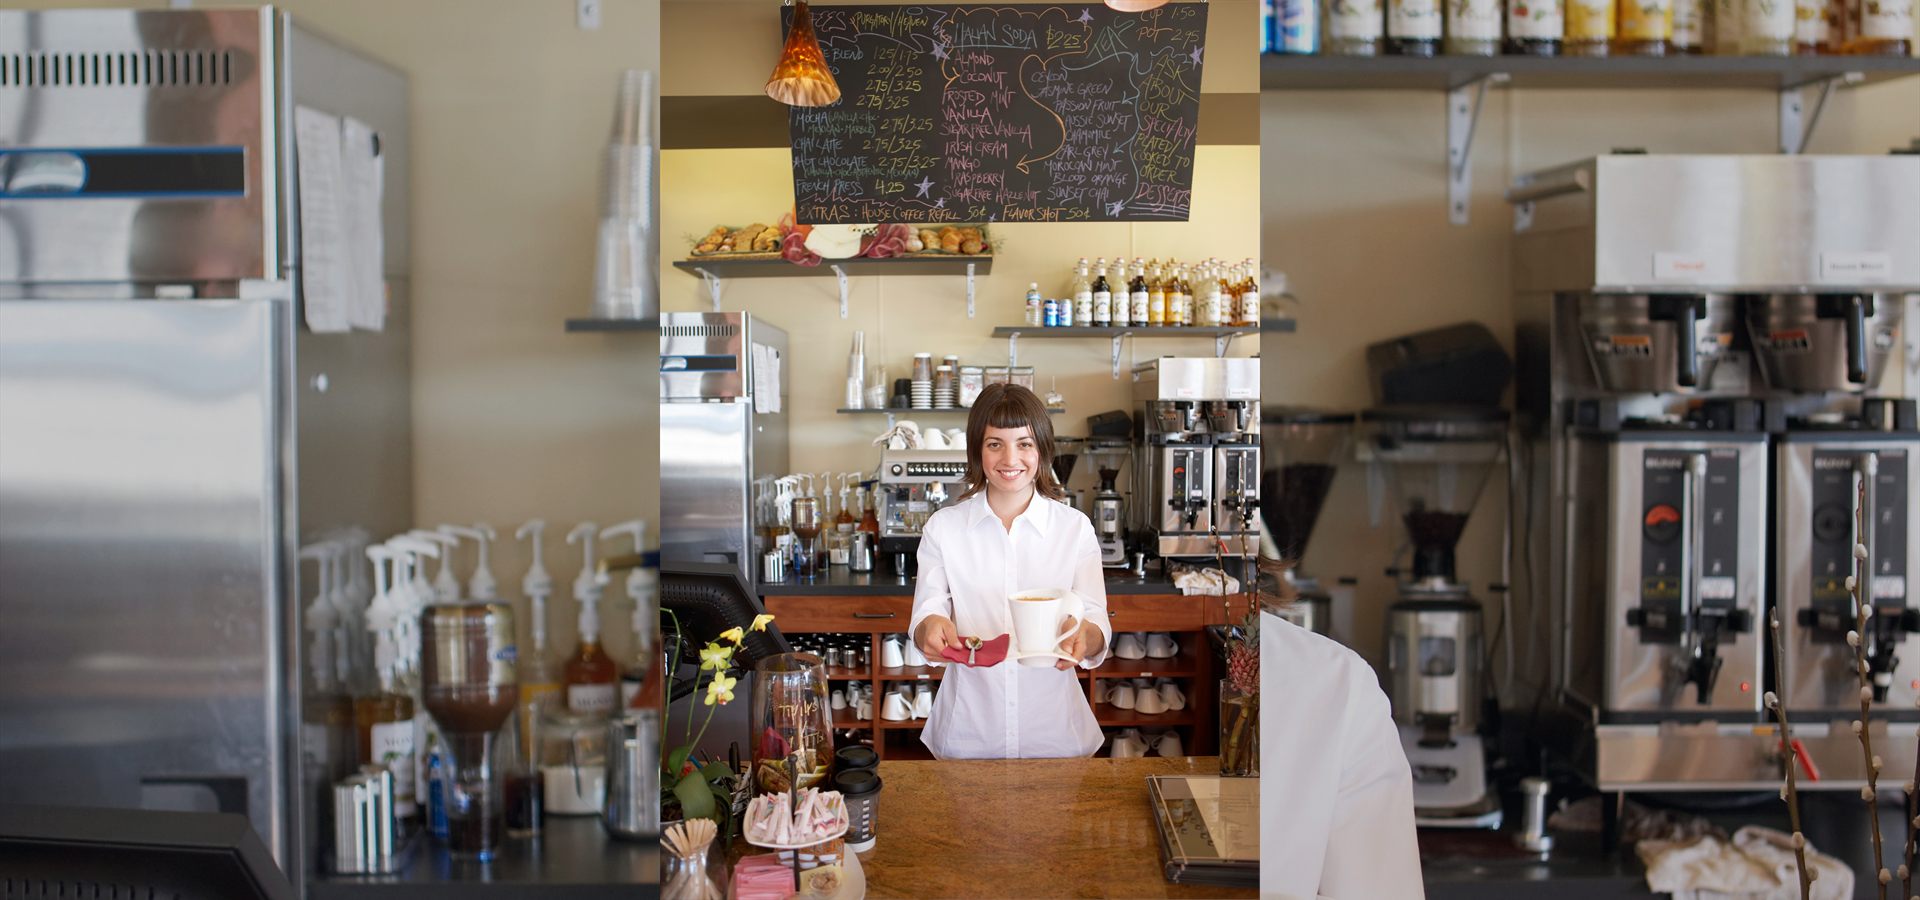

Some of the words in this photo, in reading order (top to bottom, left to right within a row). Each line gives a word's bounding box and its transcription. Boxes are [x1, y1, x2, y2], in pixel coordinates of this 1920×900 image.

[1140, 9, 1163, 29] CUP
[1172, 6, 1196, 20] 1.50
[954, 18, 996, 49] ITALIAN
[1002, 24, 1038, 50] SODA
[1137, 26, 1172, 43] POT
[1171, 29, 1199, 49] 2.95
[832, 45, 864, 60] BLEND
[954, 49, 995, 71] ALMOND
[960, 68, 1008, 88] COCONUT
[1152, 54, 1194, 92] ASK
[942, 88, 985, 108] FROSTED
[991, 87, 1016, 110] MINT
[1077, 79, 1113, 99] GREEN
[1138, 74, 1199, 104] ABOUT
[796, 111, 829, 130] MOCHA
[942, 105, 994, 125] VANILLA
[1140, 100, 1178, 122] OUR
[1096, 112, 1132, 132] SUNSET
[794, 139, 814, 154] CHAI
[816, 139, 842, 157] LATTE
[945, 141, 972, 156] IRISH
[975, 141, 1008, 159] CREAM
[1083, 143, 1109, 161] GREY
[818, 155, 868, 174] CHOCOLATE
[945, 155, 980, 177] MANGO
[1134, 150, 1170, 166] COOKED
[1175, 154, 1190, 169] TO
[1053, 172, 1086, 185] BLOOD
[1140, 163, 1184, 184] ORDER
[796, 179, 830, 196] FRENCH
[831, 180, 863, 196] PRESS
[875, 179, 904, 194] 4.25
[1047, 186, 1088, 205] SUNSET
[1088, 186, 1109, 207] CHAI
[861, 203, 891, 222] HOUSE
[893, 204, 924, 220] COFFEE
[927, 206, 961, 222] REFILL
[1003, 203, 1035, 221] FLAVOR
[1036, 207, 1067, 222] SHOT
